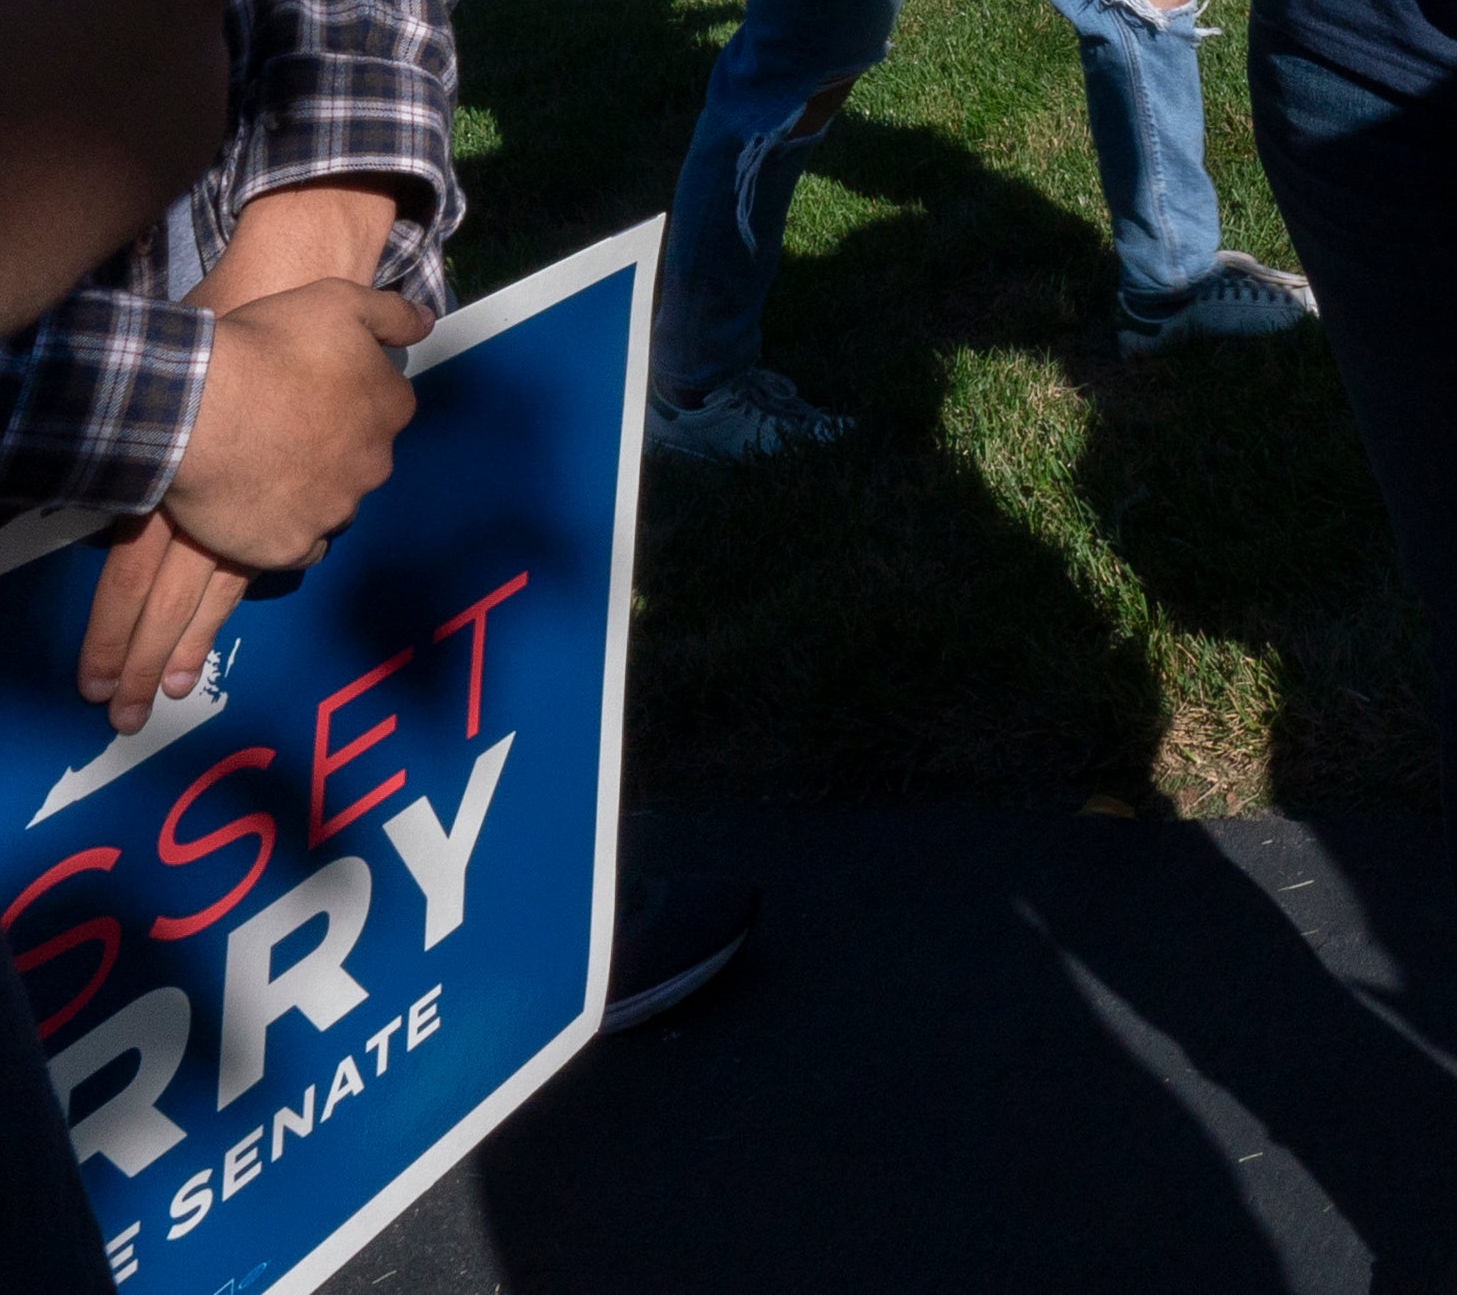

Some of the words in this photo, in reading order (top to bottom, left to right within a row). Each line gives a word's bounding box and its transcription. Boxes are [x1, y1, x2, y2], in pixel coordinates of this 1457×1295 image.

[0, 570, 530, 1042] SSET
[45, 730, 517, 1178] RRY
[166, 983, 443, 1241] SENATE
